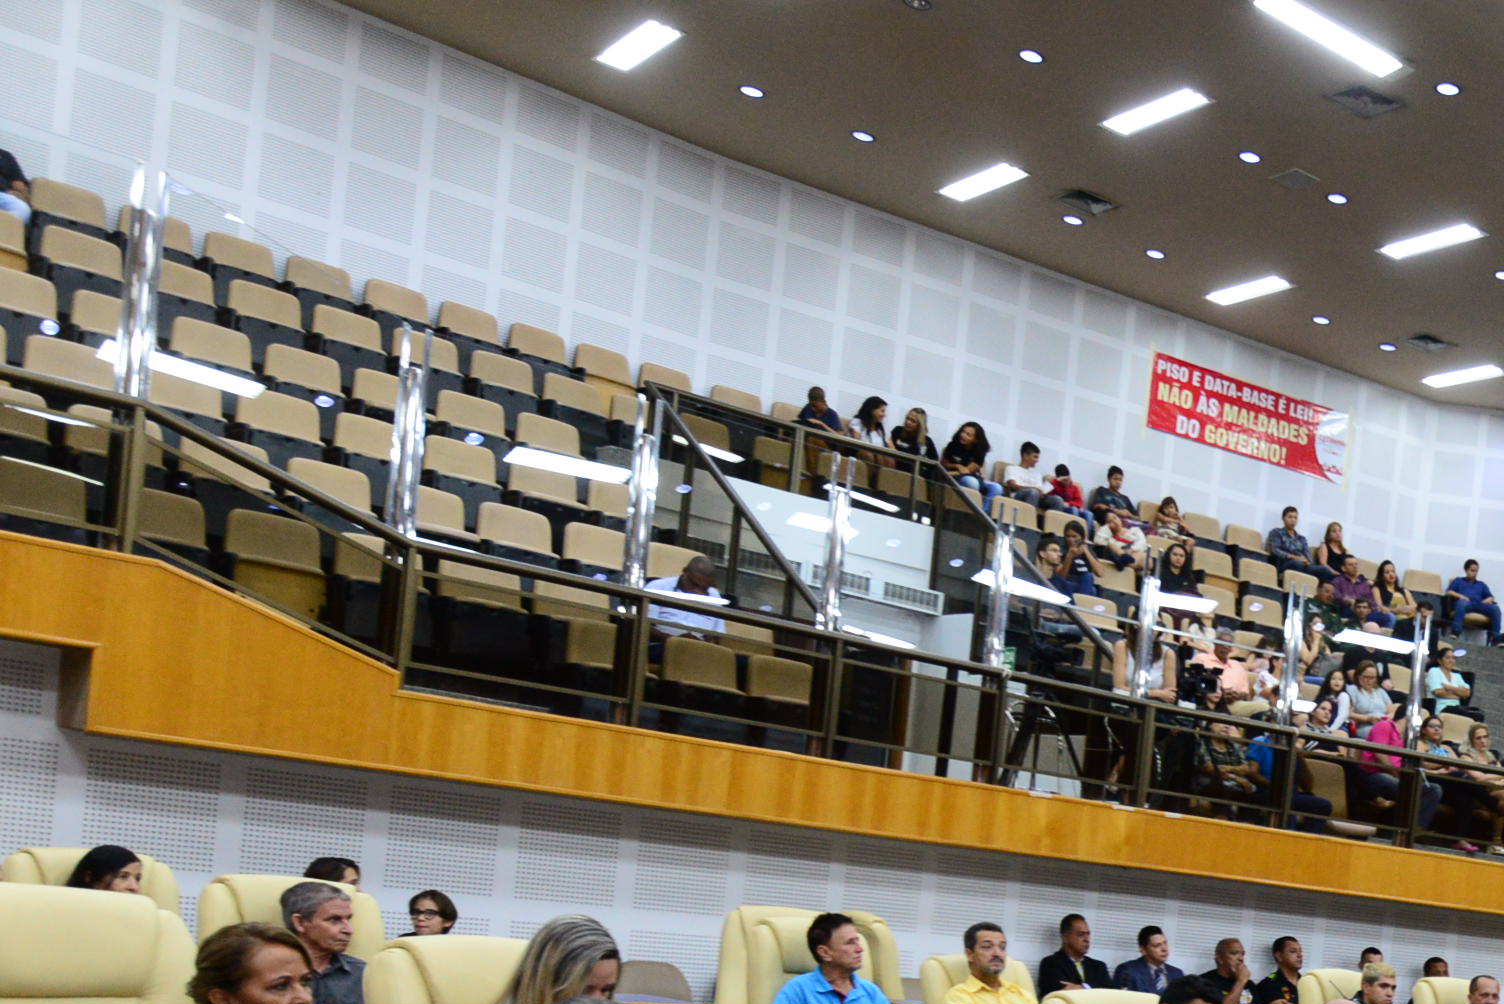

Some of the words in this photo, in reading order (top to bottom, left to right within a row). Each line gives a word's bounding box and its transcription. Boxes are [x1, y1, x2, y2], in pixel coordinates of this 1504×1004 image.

[1157, 359, 1188, 383] PISO
[1192, 372, 1202, 387] E
[1204, 375, 1275, 410] DATA-BASE
[1278, 396, 1287, 414] É
[1157, 381, 1193, 409] NÃO
[1196, 391, 1219, 417] ÀS
[1223, 403, 1309, 445] MALDADES
[1175, 415, 1200, 438] DO
[1204, 424, 1287, 464] GOVERNO!
